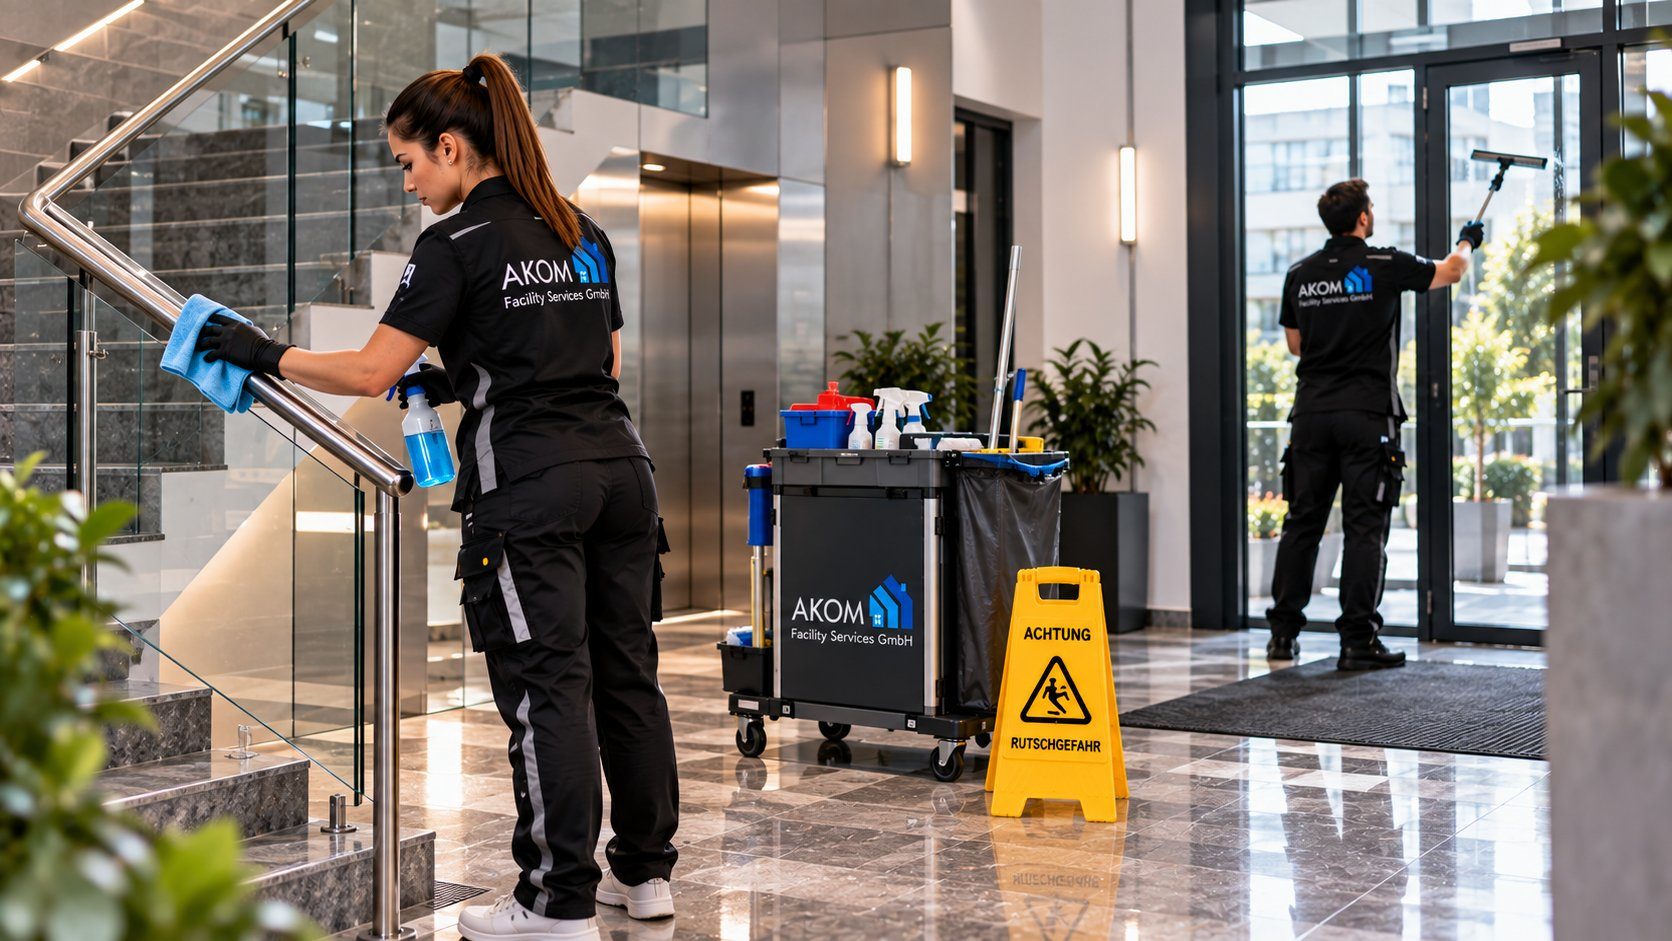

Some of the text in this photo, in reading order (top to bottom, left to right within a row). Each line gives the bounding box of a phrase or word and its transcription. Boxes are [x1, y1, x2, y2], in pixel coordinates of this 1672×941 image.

[502, 259, 574, 290] AKOM
[504, 288, 610, 309] Facility Services GmbH
[1298, 280, 1343, 298] AKOM
[791, 596, 865, 625] AKOM
[791, 628, 913, 647] Facility Services GmbH
[1023, 626, 1092, 641] ACHTUNG
[1010, 736, 1101, 753] RUTSCHGEFAHR
